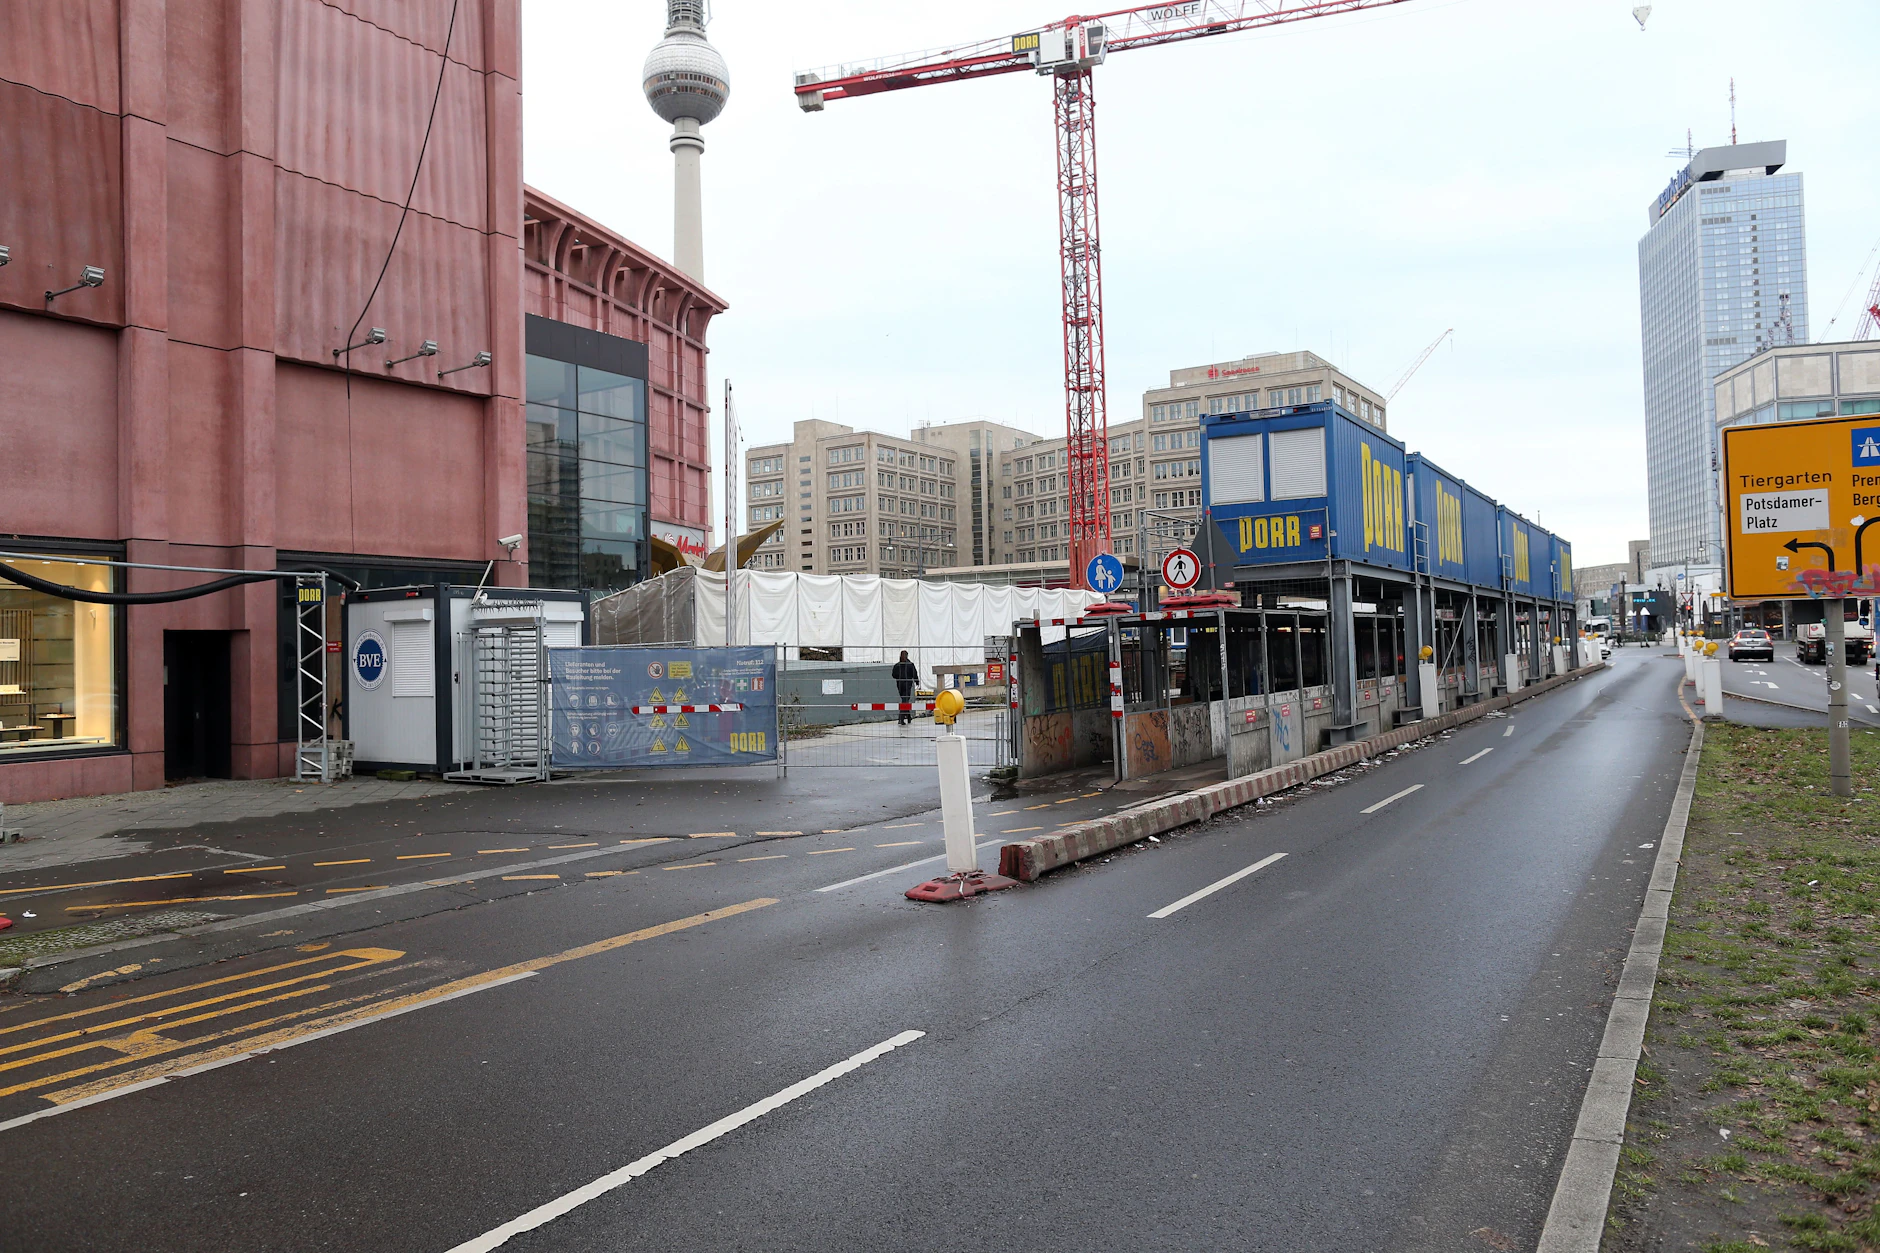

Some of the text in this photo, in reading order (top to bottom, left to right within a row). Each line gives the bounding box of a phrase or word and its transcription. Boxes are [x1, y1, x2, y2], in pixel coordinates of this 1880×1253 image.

[1150, 3, 1199, 21] WOLFF
[1014, 34, 1039, 52] PORR
[1740, 471, 1832, 488] Tiergarten
[1361, 441, 1404, 553] PORR
[1746, 497, 1822, 511] Potsdamer-
[1436, 479, 1463, 567] PORR
[1747, 516, 1778, 529] Platz
[1239, 515, 1301, 553] PORR
[299, 588, 321, 603] PORR
[359, 653, 381, 668] BVE
[730, 731, 765, 754] PORR
